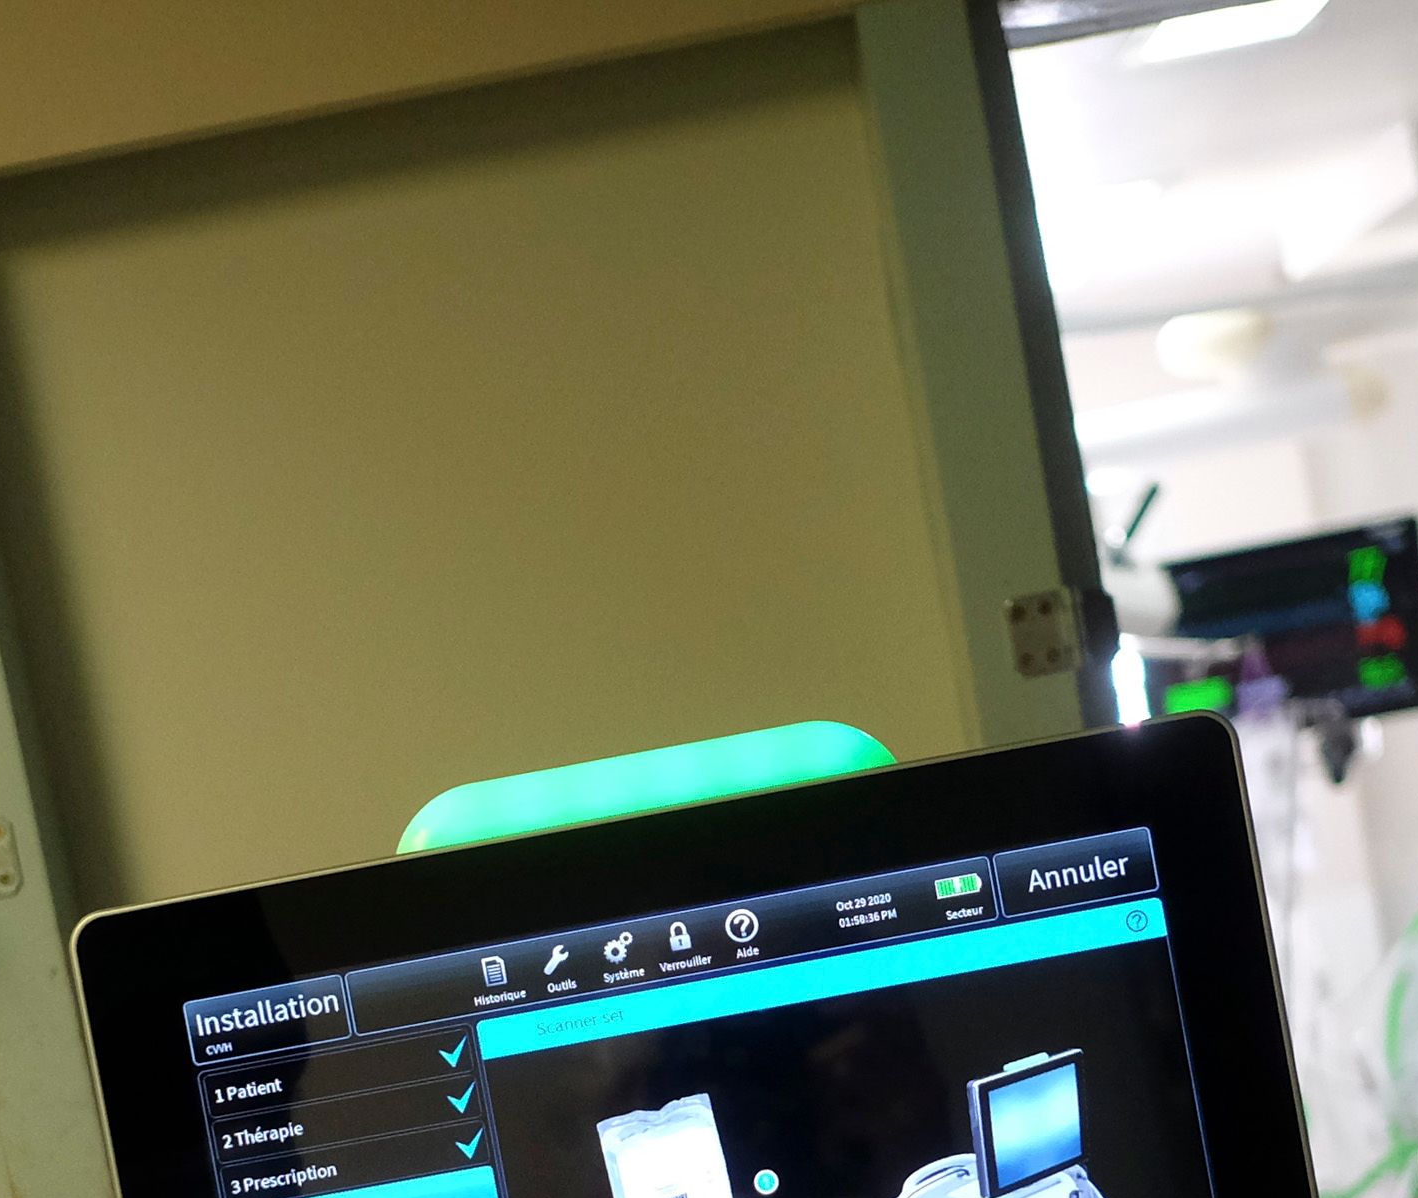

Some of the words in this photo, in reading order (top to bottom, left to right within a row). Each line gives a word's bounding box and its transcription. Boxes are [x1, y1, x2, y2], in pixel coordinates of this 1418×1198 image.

[1028, 855, 1129, 893] Annuler
[836, 901, 854, 912] Oct
[854, 897, 867, 909] 29
[867, 893, 892, 907] 2020
[838, 911, 880, 928] 01:58:36
[881, 907, 898, 920] PM
[945, 906, 984, 921] Secteur
[736, 945, 760, 959] Aide
[659, 954, 712, 973] Verrouiller
[603, 967, 645, 984] Système
[547, 979, 578, 993] Outils
[474, 988, 527, 1007] Historique
[195, 994, 340, 1037] Installation
[536, 1015, 597, 1036] Scanner
[214, 1088, 225, 1104] 1
[226, 1078, 283, 1101] Patient
[222, 1134, 234, 1149] 2
[234, 1121, 304, 1147] Thérapie
[230, 1180, 241, 1194] 3
[243, 1165, 338, 1192] Prescription
